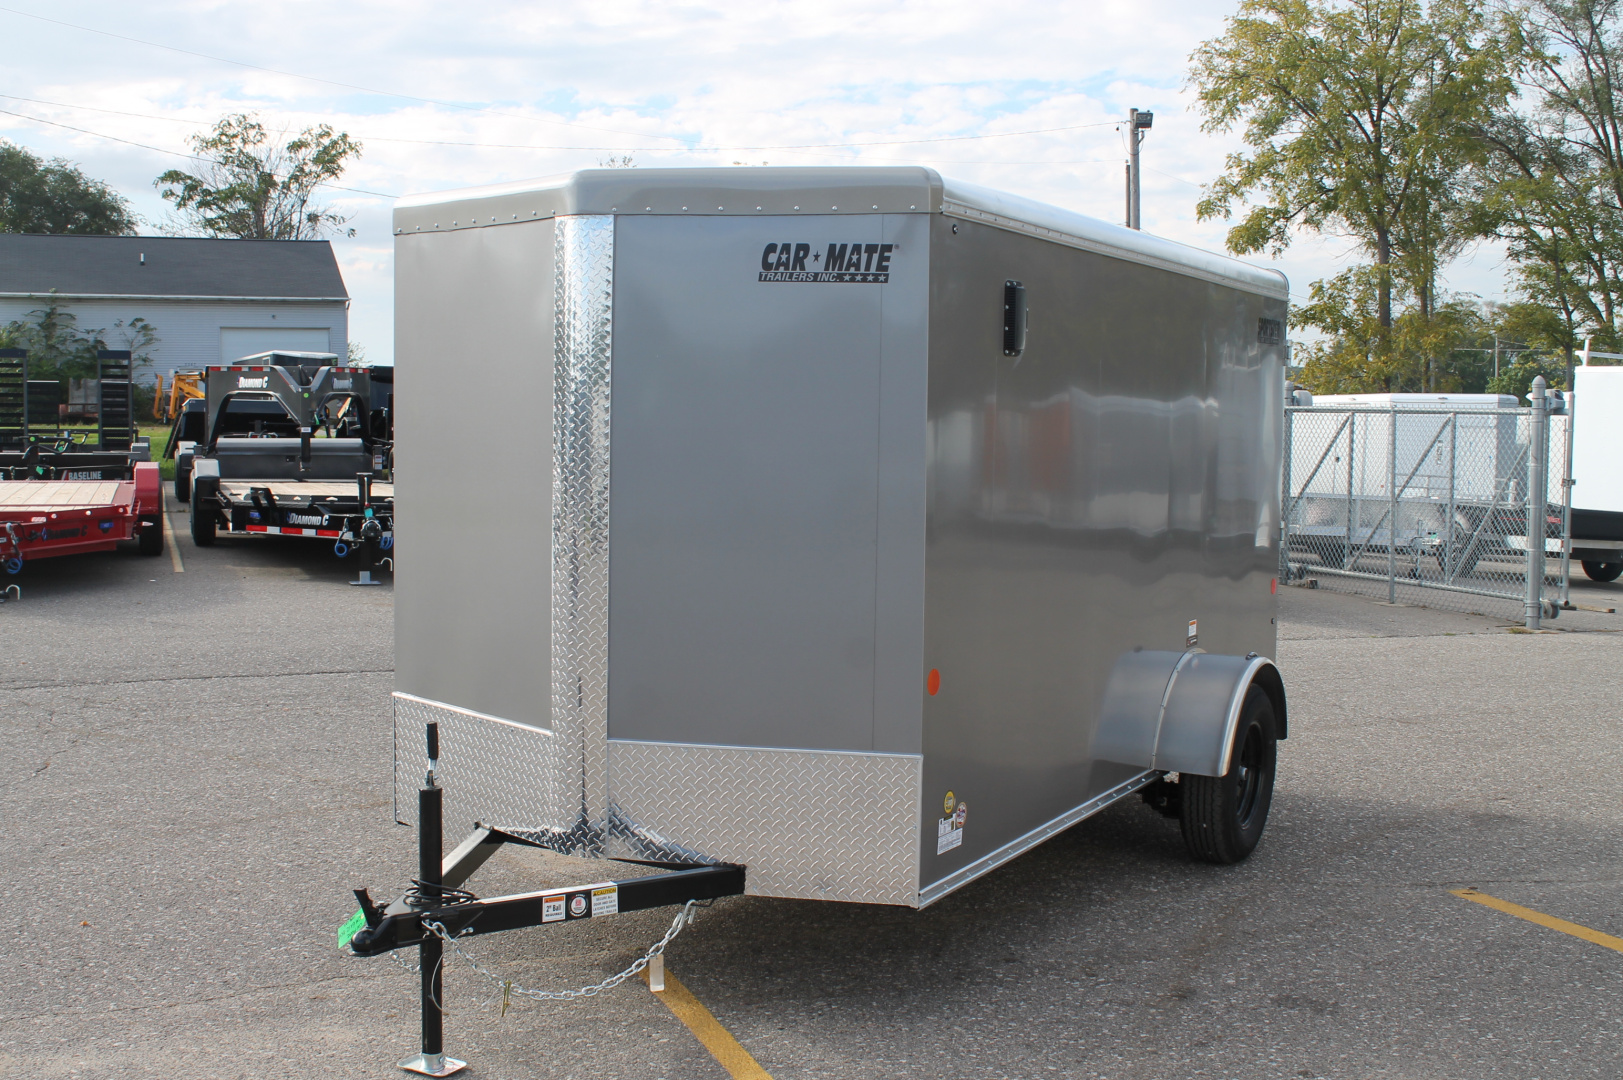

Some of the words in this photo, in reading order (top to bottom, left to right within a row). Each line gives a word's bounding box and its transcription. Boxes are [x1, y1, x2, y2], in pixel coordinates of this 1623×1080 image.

[761, 243, 810, 271] CAR
[823, 243, 893, 272] MATE
[760, 272, 815, 282] TRAILERS
[817, 273, 840, 282] INC.
[262, 376, 269, 389] C
[68, 471, 102, 480] BASELINE
[289, 512, 322, 526] DIAMOND
[322, 514, 329, 526] C
[552, 903, 562, 912] Ball
